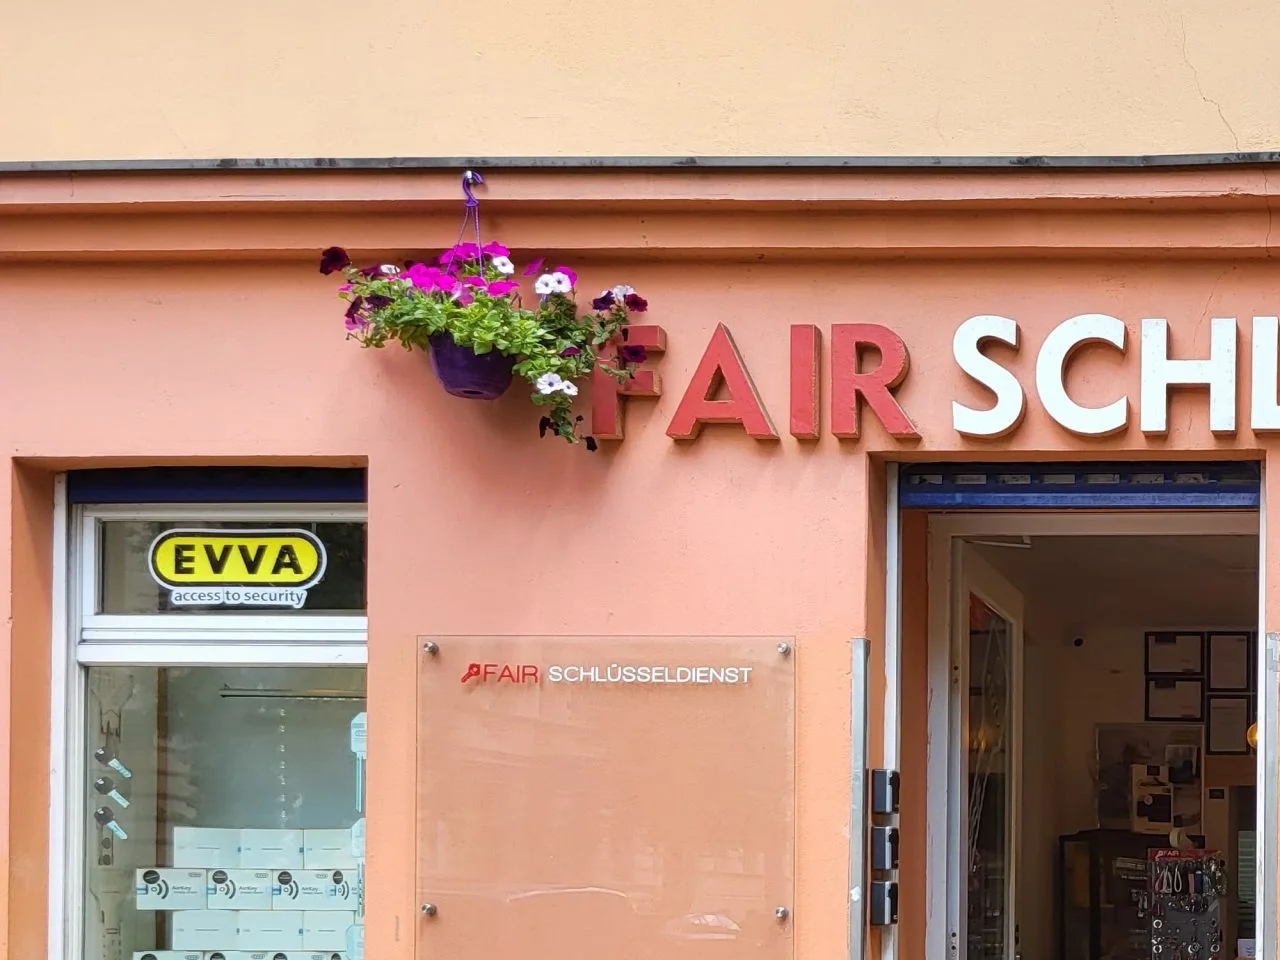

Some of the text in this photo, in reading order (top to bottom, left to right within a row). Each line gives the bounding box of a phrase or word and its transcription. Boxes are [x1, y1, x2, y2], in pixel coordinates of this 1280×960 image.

[592, 320, 923, 441] FAIR
[173, 544, 304, 575] EVVA
[174, 589, 304, 605] access to security
[482, 664, 753, 683] FAIR SCHLÜSSELDIENST
